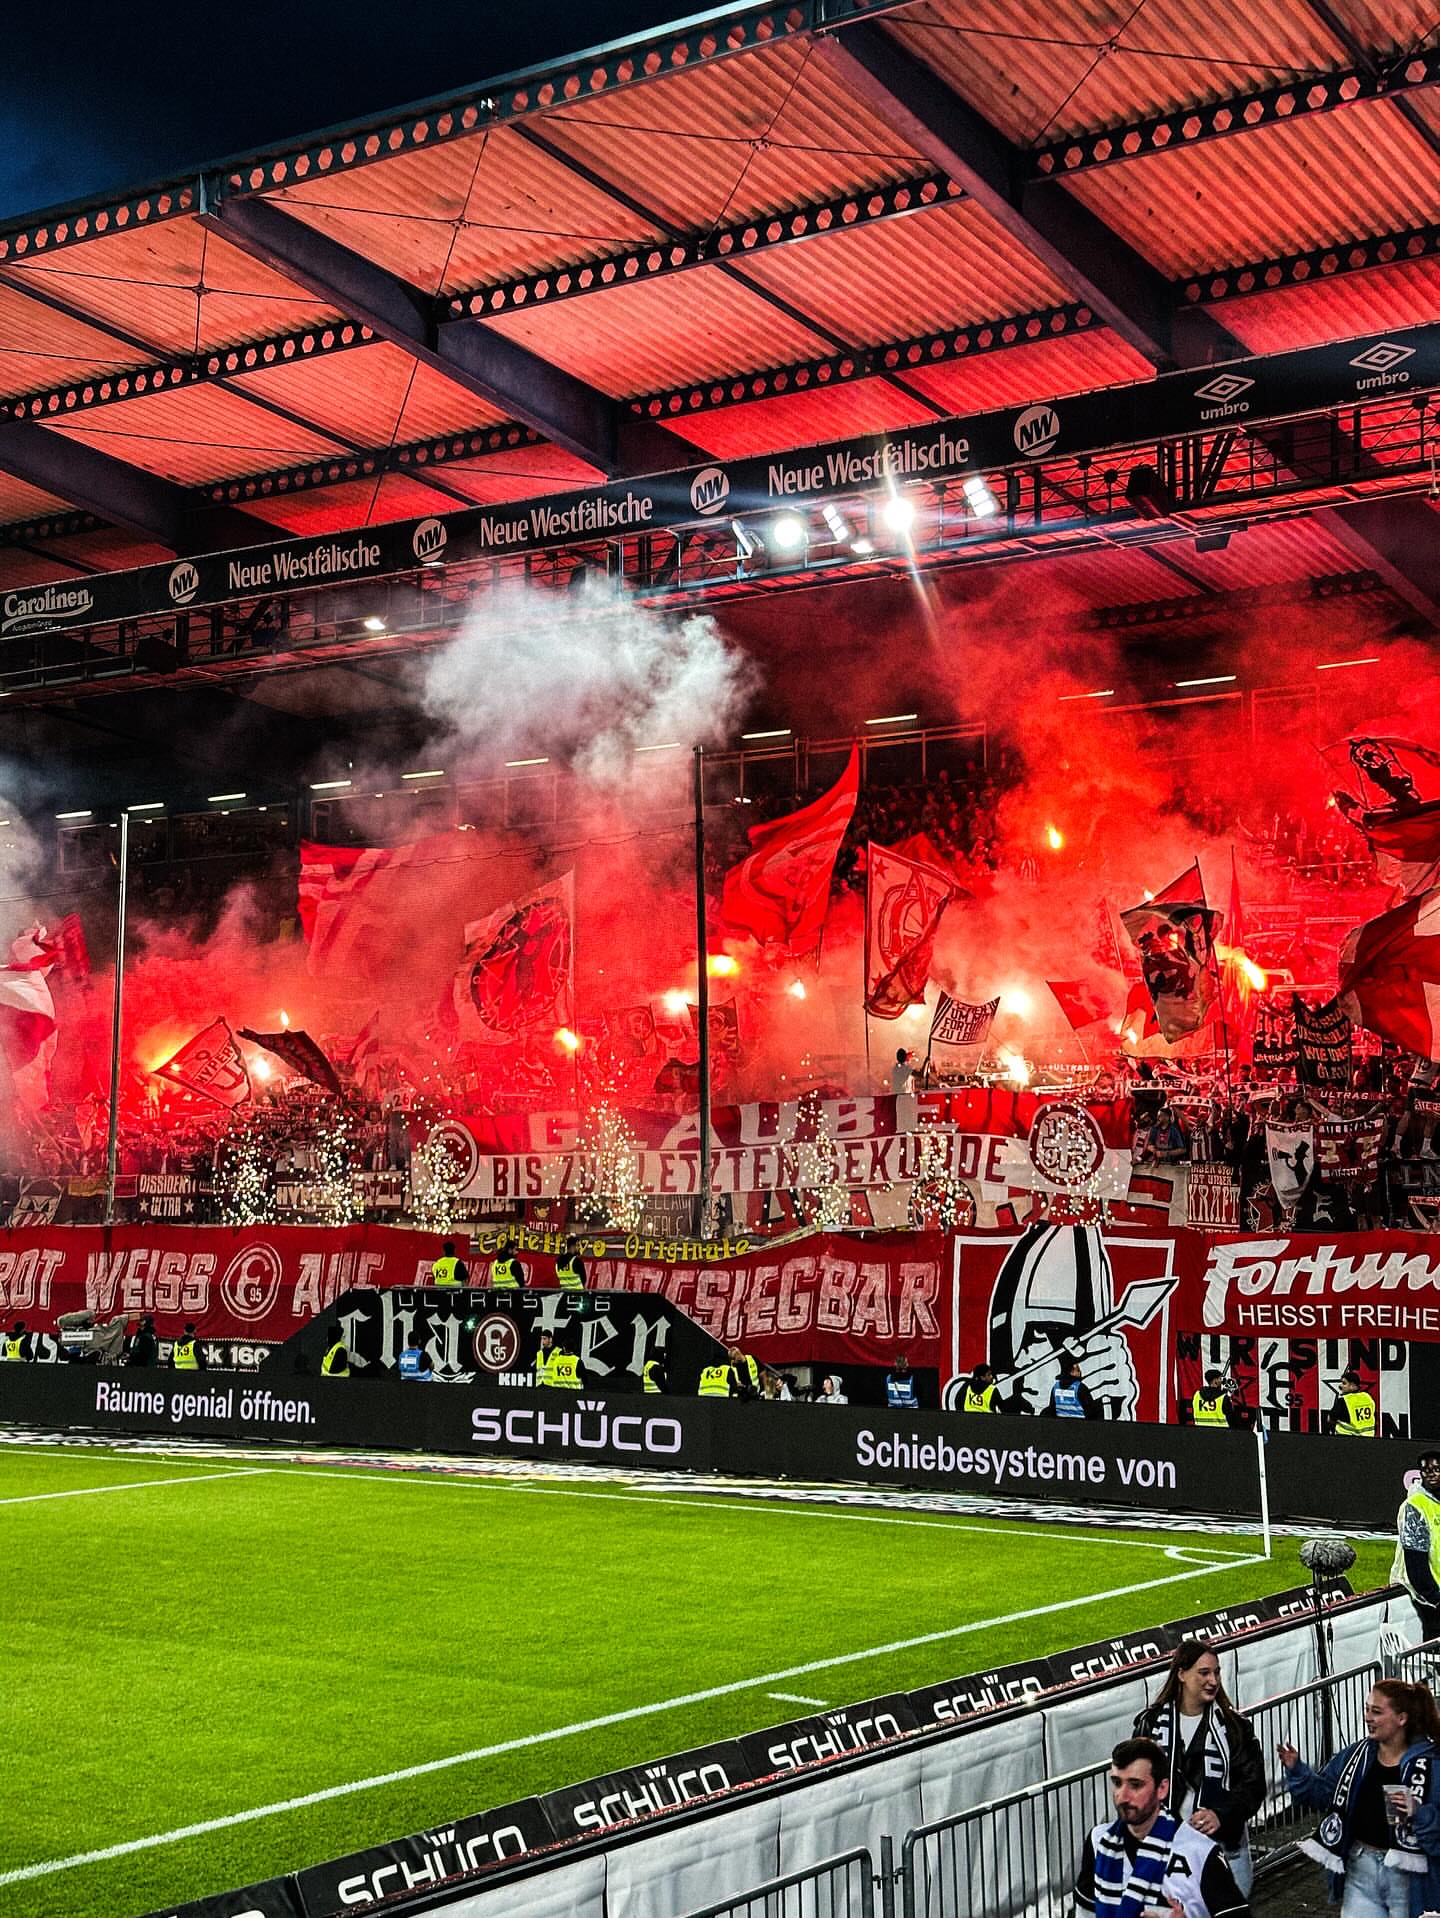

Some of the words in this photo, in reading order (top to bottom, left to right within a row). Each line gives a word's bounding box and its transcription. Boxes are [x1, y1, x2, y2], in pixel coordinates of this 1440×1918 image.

[1356, 371, 1409, 390] umbro
[1201, 401, 1250, 420] umbro
[1019, 415, 1056, 446] NW
[768, 464, 825, 497] Neue
[827, 433, 969, 486] Westfälische
[694, 475, 725, 502] NW
[480, 517, 528, 547] Neue
[530, 492, 654, 536] Westfälische
[416, 526, 445, 554] NW
[228, 561, 271, 590] Neue
[272, 540, 381, 580] Westfälische
[172, 568, 195, 596] NW
[4, 587, 91, 617] Carolinen
[493, 1156, 543, 1197] BIS
[478, 1224, 608, 1258] Collettvo
[85, 1249, 218, 1313] WEISS
[435, 1268, 448, 1280] K9
[1238, 1304, 1332, 1327] HEISST
[556, 1365, 572, 1377] K9
[1290, 1338, 1407, 1371] SIND
[705, 1367, 723, 1381] K9
[96, 1382, 164, 1415] Räume
[171, 1388, 233, 1423] genial
[240, 1390, 316, 1423] öffnen.
[969, 1393, 984, 1406] K9
[1198, 1399, 1217, 1412] K9
[1355, 1407, 1372, 1421] K9
[472, 1400, 682, 1453] SCHÜCO
[857, 1429, 1106, 1485] Schiebesysteme
[1116, 1456, 1177, 1489] von
[1070, 1640, 1161, 1681] SCHÜCO
[934, 1674, 1042, 1721] SCHÜCO
[768, 1712, 903, 1773] SCHÜCO
[573, 1763, 731, 1831] SCHÜCO
[338, 1826, 529, 1905] SCHÜCO
